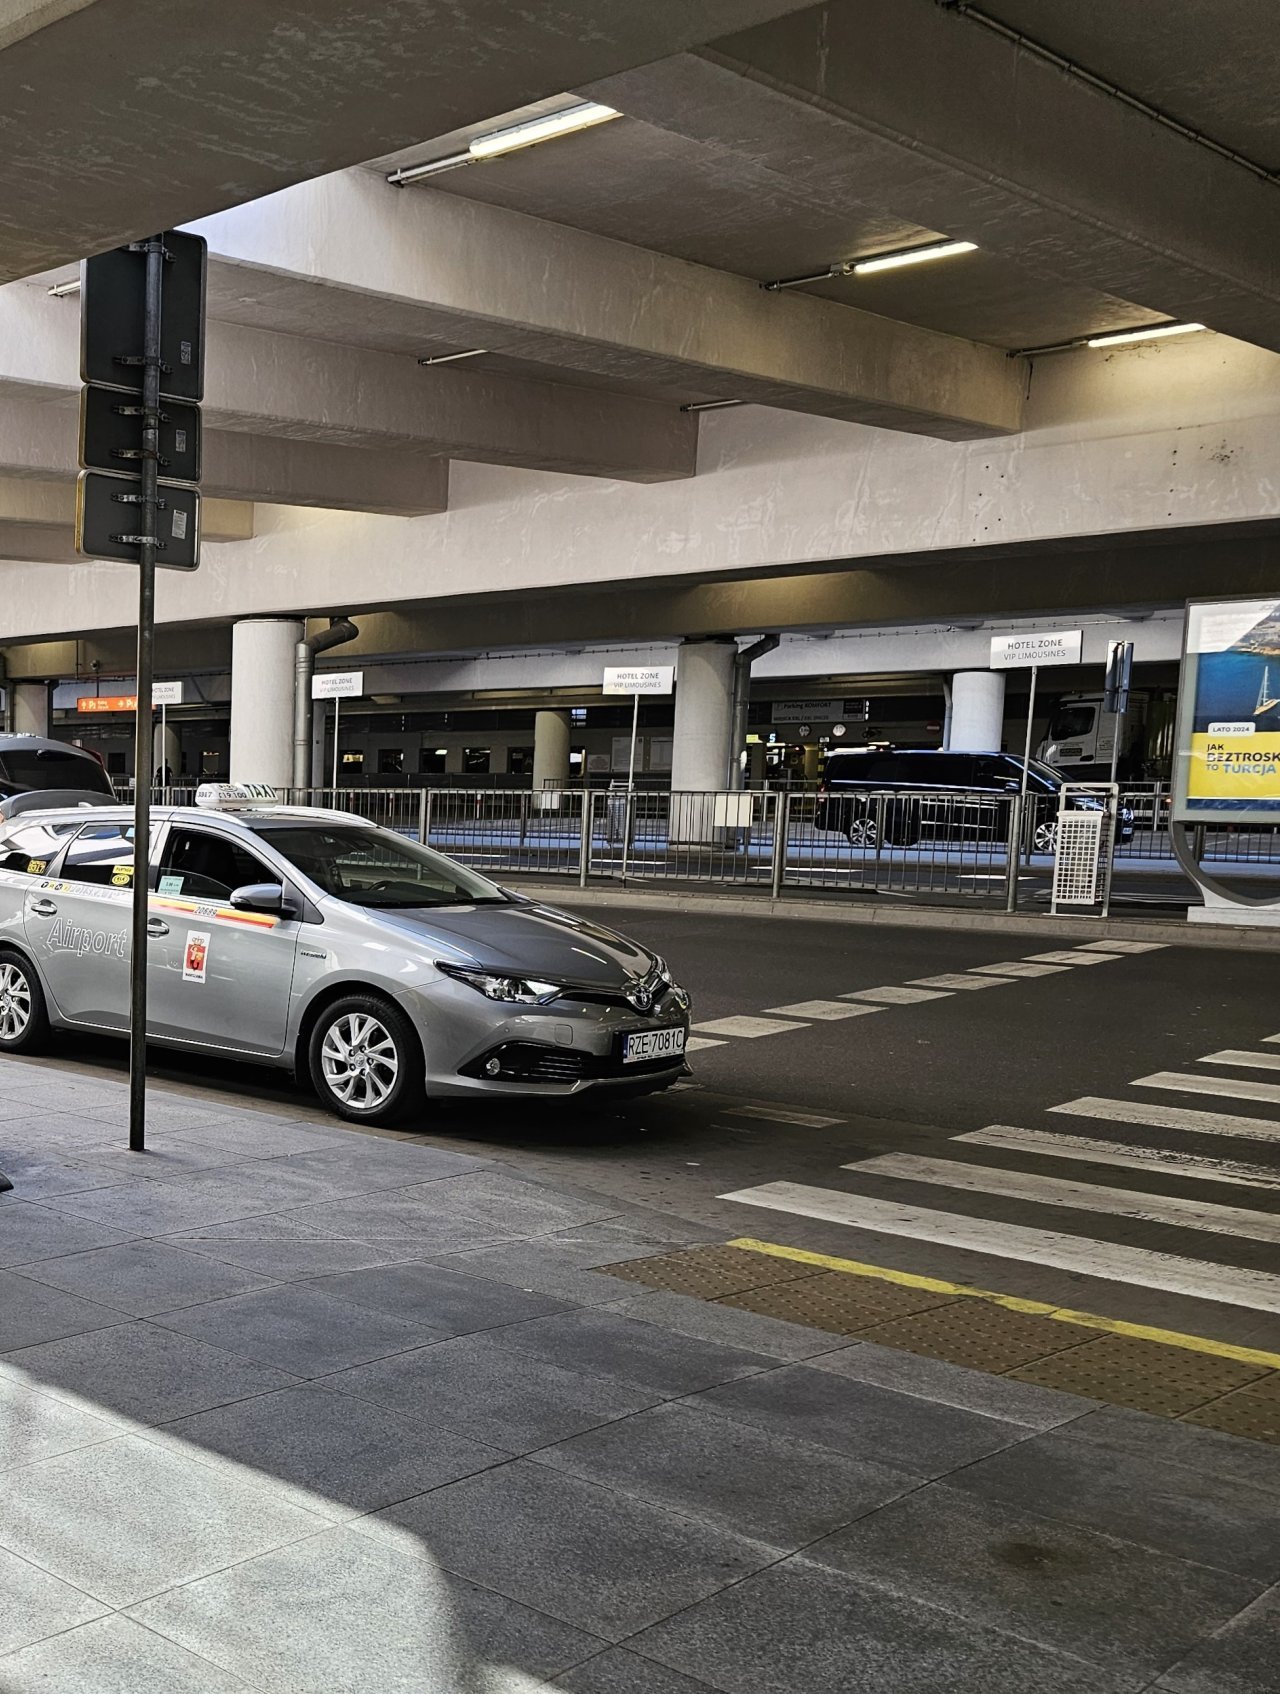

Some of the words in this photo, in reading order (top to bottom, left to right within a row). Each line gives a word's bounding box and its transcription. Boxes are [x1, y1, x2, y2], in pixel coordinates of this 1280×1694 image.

[1007, 641, 1035, 650] HOTEL
[1038, 638, 1063, 648] ZONE
[1003, 653, 1016, 661] VIP
[1017, 649, 1066, 660] LIMOUSINES
[624, 681, 662, 689] LIMOUSINES
[1207, 744, 1224, 752] JAK
[1223, 764, 1276, 776] TURCJA
[242, 783, 276, 798] TAXI
[46, 917, 127, 957] Airport
[629, 1034, 649, 1056] RZE
[651, 1030, 683, 1053] 7081C
